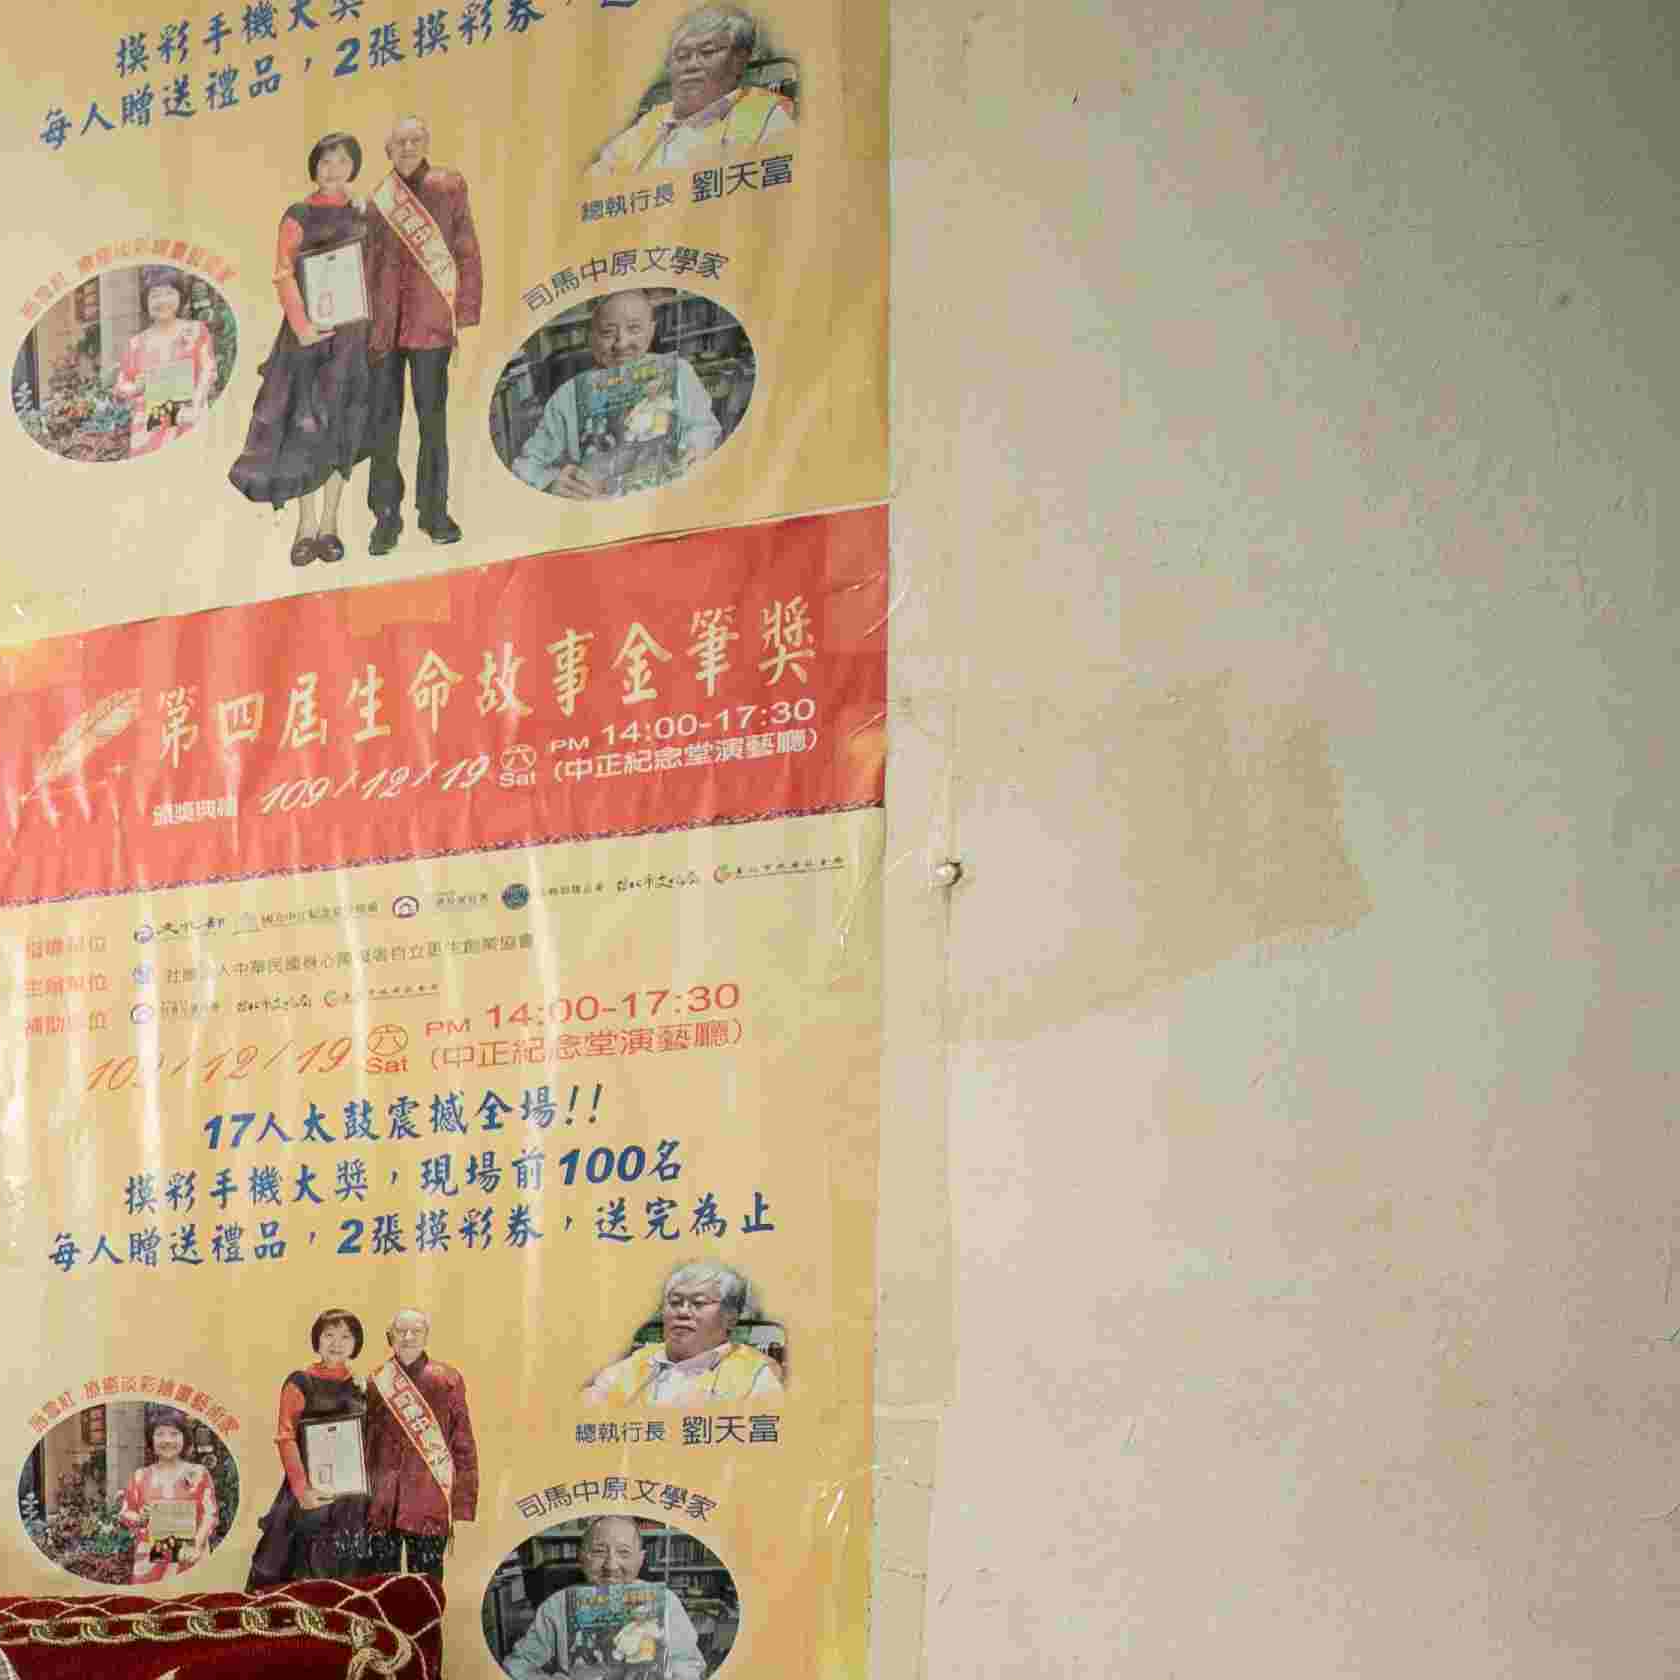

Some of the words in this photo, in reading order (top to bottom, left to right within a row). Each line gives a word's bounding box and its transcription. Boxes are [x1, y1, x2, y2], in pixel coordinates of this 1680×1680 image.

[40, 0, 638, 150] 每人贈送禮品，2張摸彩券，
[580, 183, 676, 224] 總執行長
[690, 153, 795, 204] 劉天富
[521, 246, 730, 312] 司馬中原文學家
[152, 594, 818, 768] 第四屆生命故事金筆獎
[550, 735, 590, 754] PM
[600, 696, 816, 748] 14:00-17:30
[553, 728, 818, 785] (中正紀念堂演藝廳)
[261, 752, 491, 816] 109/12/19
[498, 769, 537, 789] Sat
[425, 1019, 471, 1038] PM
[365, 1057, 409, 1074] Sat
[202, 1083, 604, 1151] 17人太鼓震撼全場!!
[124, 1139, 684, 1216] 摸彩手機大獎，現場前100名
[47, 1195, 776, 1273] 每人贈送禮品，2張摸彩券，送完為止
[574, 1421, 666, 1444] 總執行長
[681, 1414, 780, 1446] 劉天富
[516, 1476, 719, 1523] 司馬中原文學家
